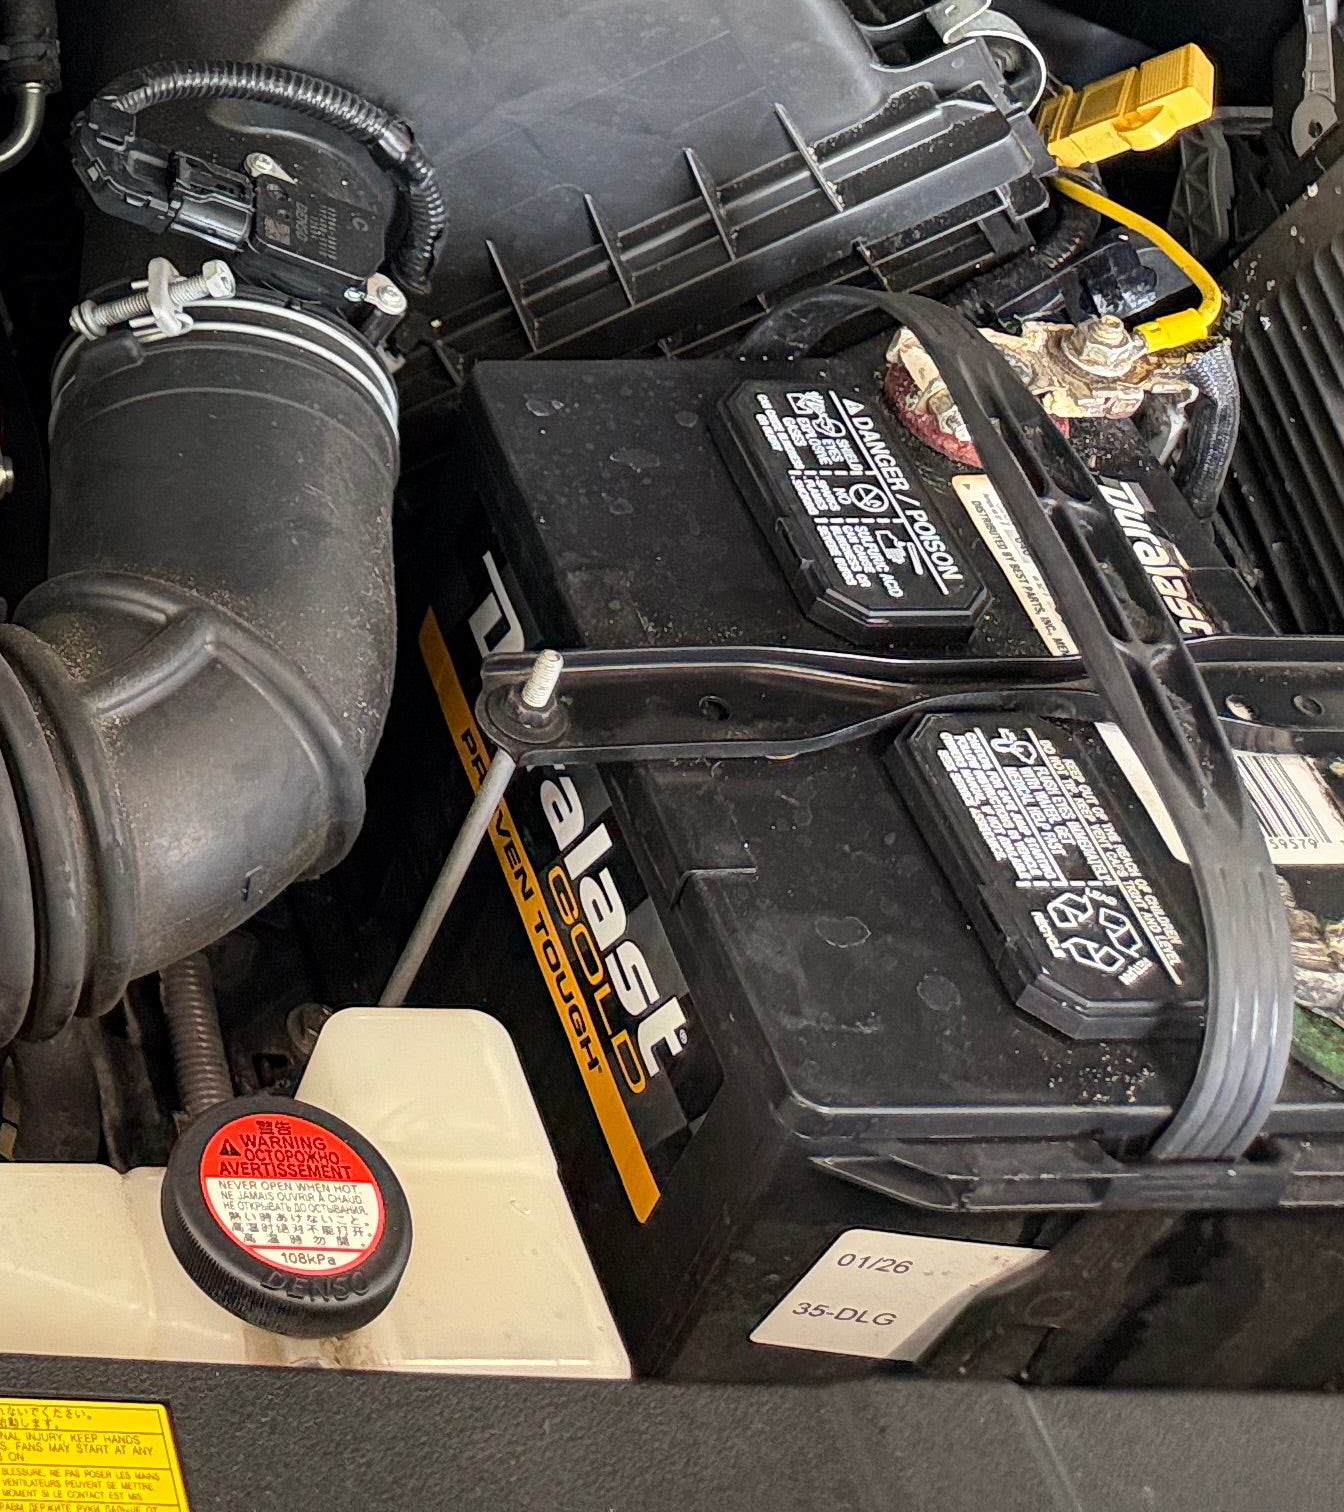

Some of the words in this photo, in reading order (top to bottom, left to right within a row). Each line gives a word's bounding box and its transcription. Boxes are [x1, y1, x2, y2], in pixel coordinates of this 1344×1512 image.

[782, 417, 807, 447] GASES
[796, 417, 833, 465] EXPLOSIVE
[822, 439, 844, 462] EYES
[836, 439, 863, 471] SHIELD
[852, 417, 909, 490] DANGER
[833, 488, 852, 505] NO
[895, 494, 920, 506] /
[905, 510, 963, 579] POISON
[972, 501, 1008, 549] DISTRIBUTED
[1002, 552, 1016, 562] BY
[1009, 564, 1029, 584] BEST
[1023, 586, 1045, 615] PARTS,
[854, 525, 889, 572] SULFURIC
[879, 574, 903, 598] ACID
[468, 550, 688, 1079] Dalast
[1003, 767, 1036, 805] MEDICAL
[1026, 806, 1052, 830] HELP
[1041, 831, 1068, 857] FAST
[1019, 766, 1043, 790] WITH
[1054, 825, 1076, 846] GET
[1033, 766, 1062, 795] FLUSH
[1051, 796, 1076, 820] EYES
[1066, 821, 1112, 881] IMMEDIATELY
[1039, 740, 1056, 755] DO
[1048, 756, 1071, 778] NOT
[1073, 798, 1097, 822] KEEP
[1090, 824, 1113, 849] VENT
[1122, 880, 1148, 910] TIGHT
[1139, 911, 1162, 934] AND
[1153, 934, 1182, 966] LEVEL
[1062, 759, 1086, 783] KEEP
[1078, 784, 1099, 806] OUT
[1101, 822, 1122, 842] THE
[1113, 844, 1142, 877] REACH
[1134, 878, 1152, 893] OF
[1144, 895, 1183, 946] CHILDREN
[461, 728, 535, 902] PRVEN
[534, 909, 601, 1073] TOUGH
[546, 865, 647, 1095] GOLD
[239, 1134, 327, 1152] WARNING
[244, 1148, 340, 1165] ОСТОРОЖНО
[219, 1161, 352, 1180] AVERTISSEMENT
[218, 1180, 257, 1191] NEVER
[260, 1181, 293, 1192] OPEN
[295, 1182, 331, 1193] WHEN
[220, 1191, 235, 1200] NE
[237, 1191, 275, 1201] JAMAIS
[281, 1252, 337, 1266] 108kPa
[837, 1253, 914, 1275] 01/26
[260, 1271, 370, 1302] DENSO
[792, 1302, 899, 1327] 35-DLG
[15, 1442, 44, 1452] FANS
[48, 1444, 70, 1454] MAY
[75, 1444, 109, 1455] START
[115, 1445, 127, 1455] AT
[133, 1446, 153, 1456] ANY
[70, 1434, 98, 1444] KEEP
[103, 1435, 141, 1445] HANDS
